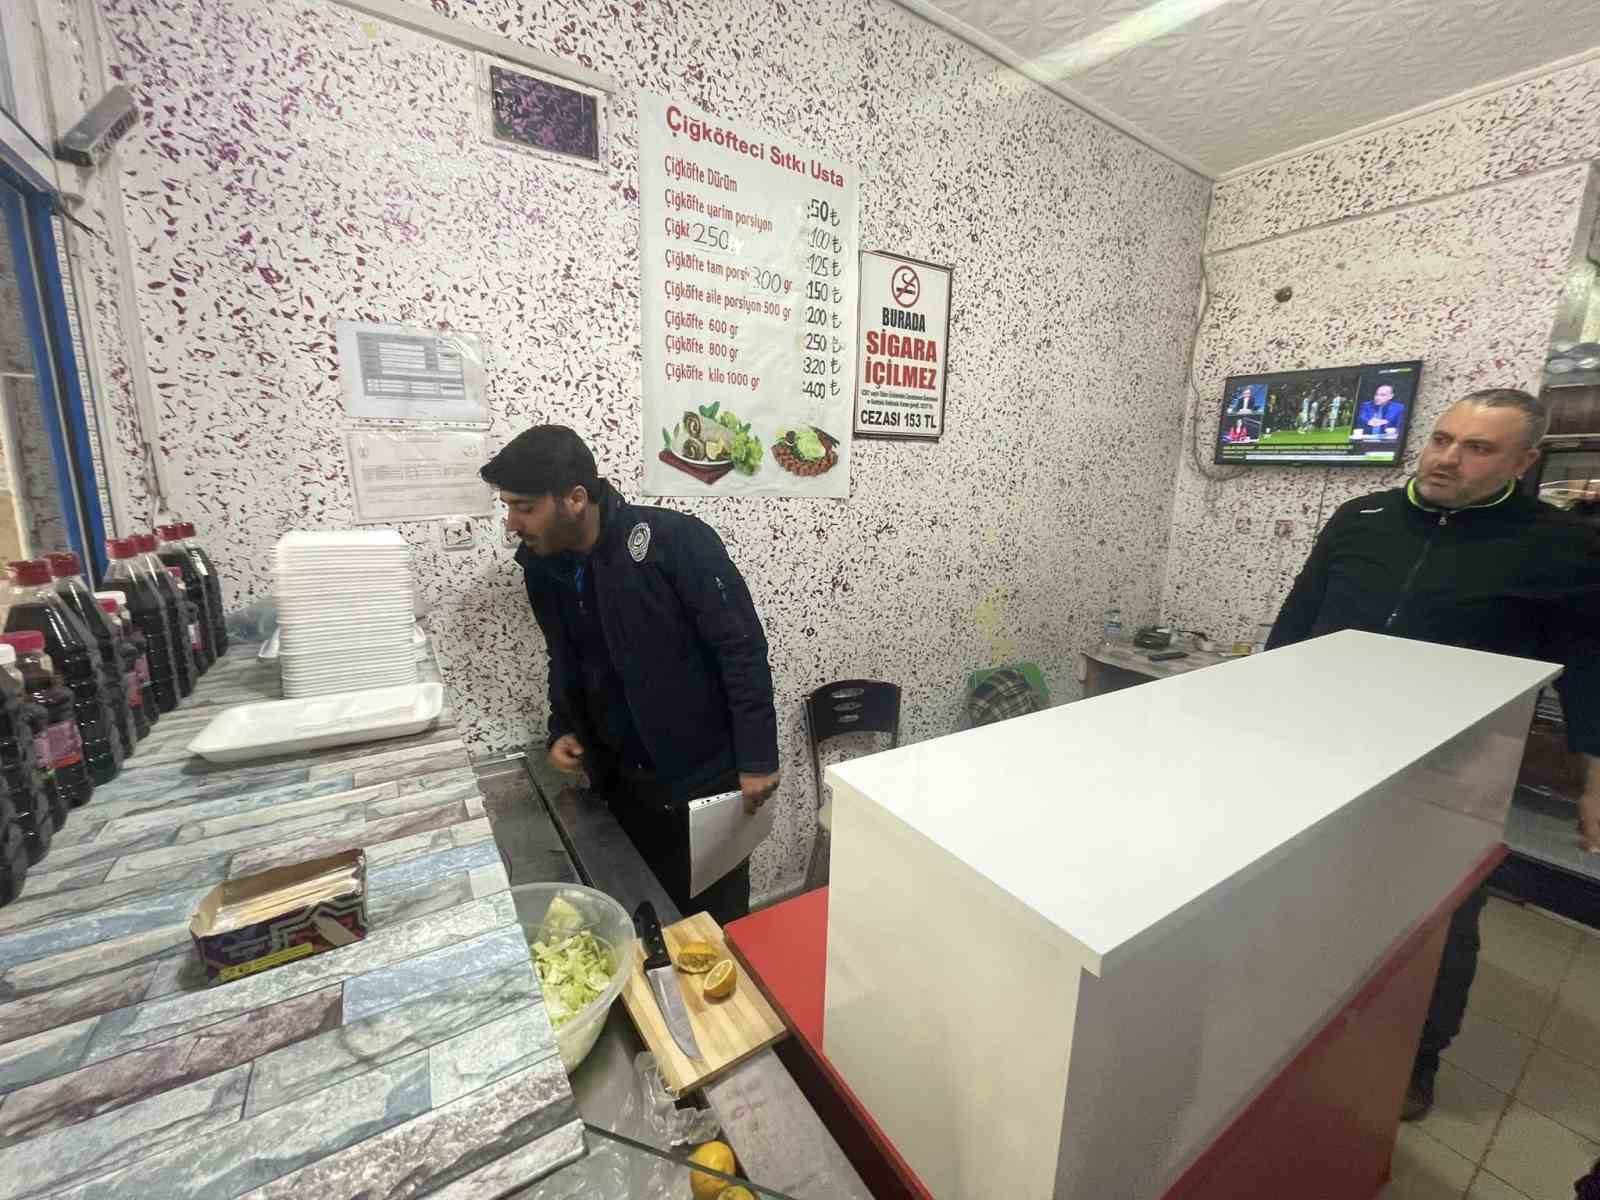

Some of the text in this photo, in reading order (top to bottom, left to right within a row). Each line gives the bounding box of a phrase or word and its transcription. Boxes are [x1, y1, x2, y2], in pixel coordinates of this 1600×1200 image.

[666, 105, 844, 188] Çiğköfteci Sıtkı Usta
[665, 155, 738, 192] Çiğköfte Dürüm
[665, 189, 704, 213] Çiğköfte
[736, 210, 773, 232] porsiyon
[665, 249, 704, 272] Çiğköfte
[707, 258, 723, 276] tam
[784, 279, 793, 295] gr
[665, 280, 792, 322] Çiğköfte aile porsiyon 500 gr
[665, 310, 739, 339] Çiğköfte 600 gr
[882, 307, 926, 332] BURADA
[665, 335, 704, 356] Çiğköfte
[729, 347, 739, 362] gr
[866, 329, 937, 363] SİGARA
[665, 362, 761, 391] Çiğköfte kilo 1000 gr
[864, 356, 936, 391] İÇİLMEZ
[861, 410, 937, 428] CEZASI 153 TL
